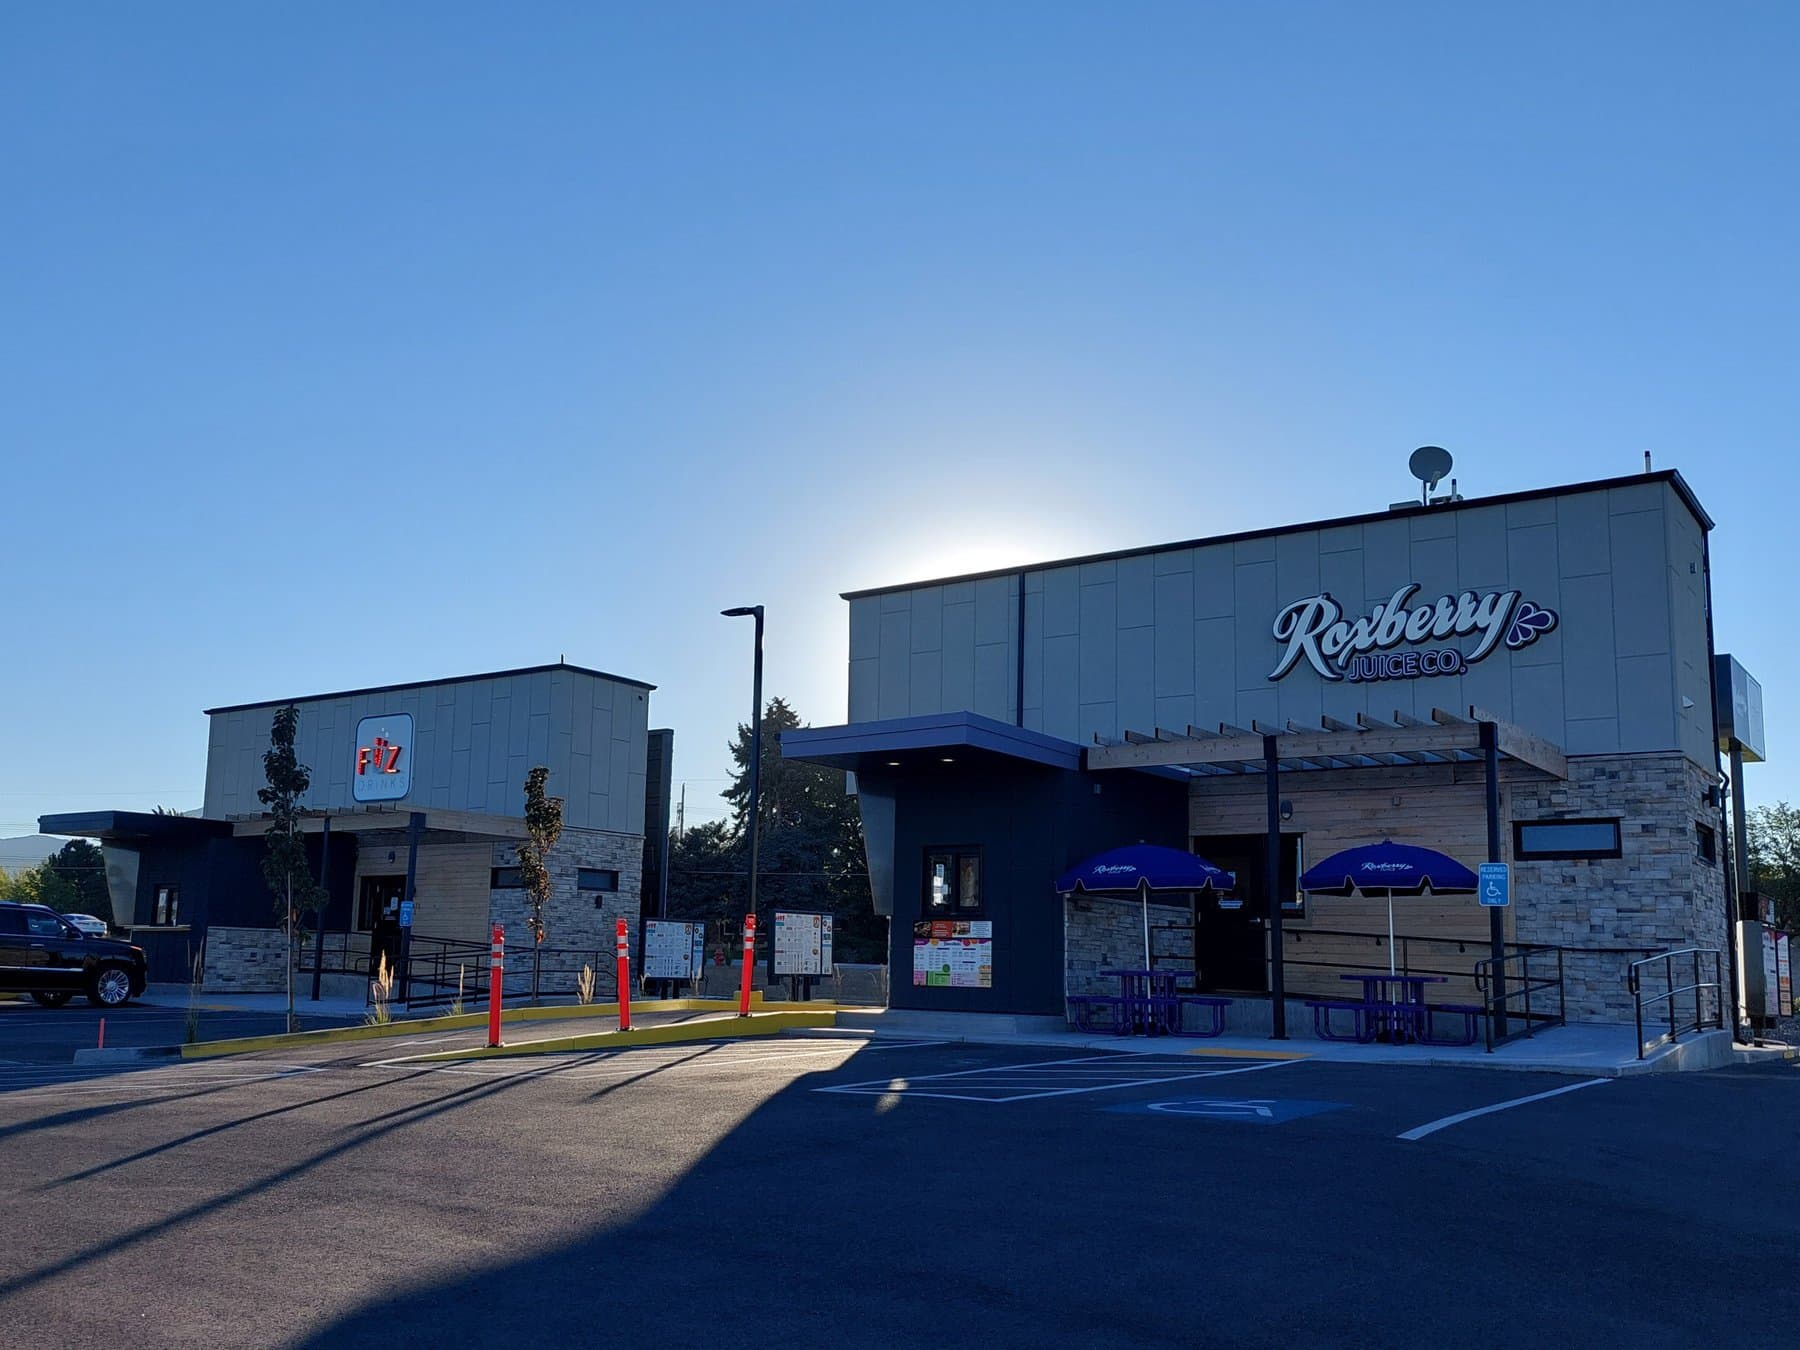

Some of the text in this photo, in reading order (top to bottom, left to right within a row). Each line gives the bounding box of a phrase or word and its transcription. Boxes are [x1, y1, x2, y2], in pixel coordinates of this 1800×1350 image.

[1268, 583, 1522, 682] Roxberry
[1348, 649, 1467, 681] JUICE CO.
[357, 776, 405, 793] DRINKS
